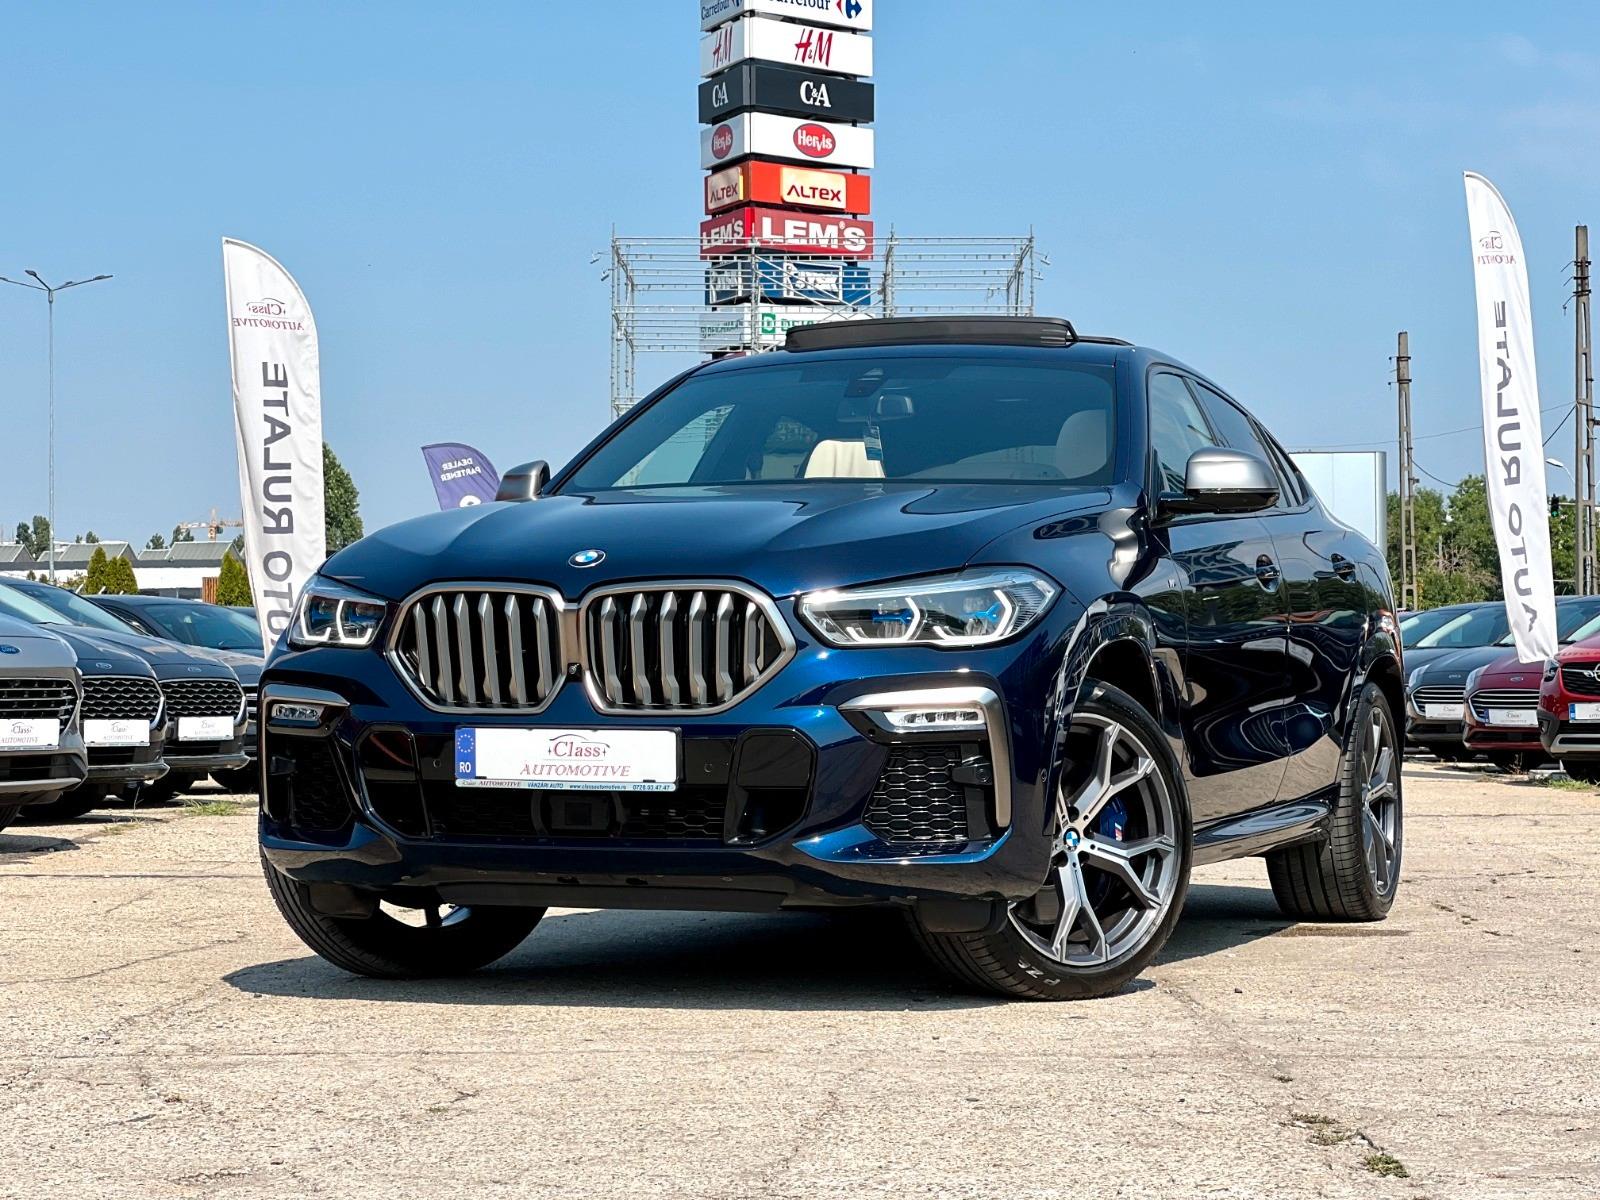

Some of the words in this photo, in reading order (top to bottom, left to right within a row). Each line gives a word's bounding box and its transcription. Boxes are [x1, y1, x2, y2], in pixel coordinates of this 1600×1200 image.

[794, 28, 833, 68] H&M
[712, 82, 728, 107] C&A
[800, 80, 831, 107] C&A
[713, 133, 732, 150] Hervis
[797, 129, 833, 151] Hervis
[702, 216, 744, 250] LEM'S
[553, 741, 601, 757] Class
[459, 762, 472, 773] RO
[520, 763, 631, 777] AUTOMOTIVE
